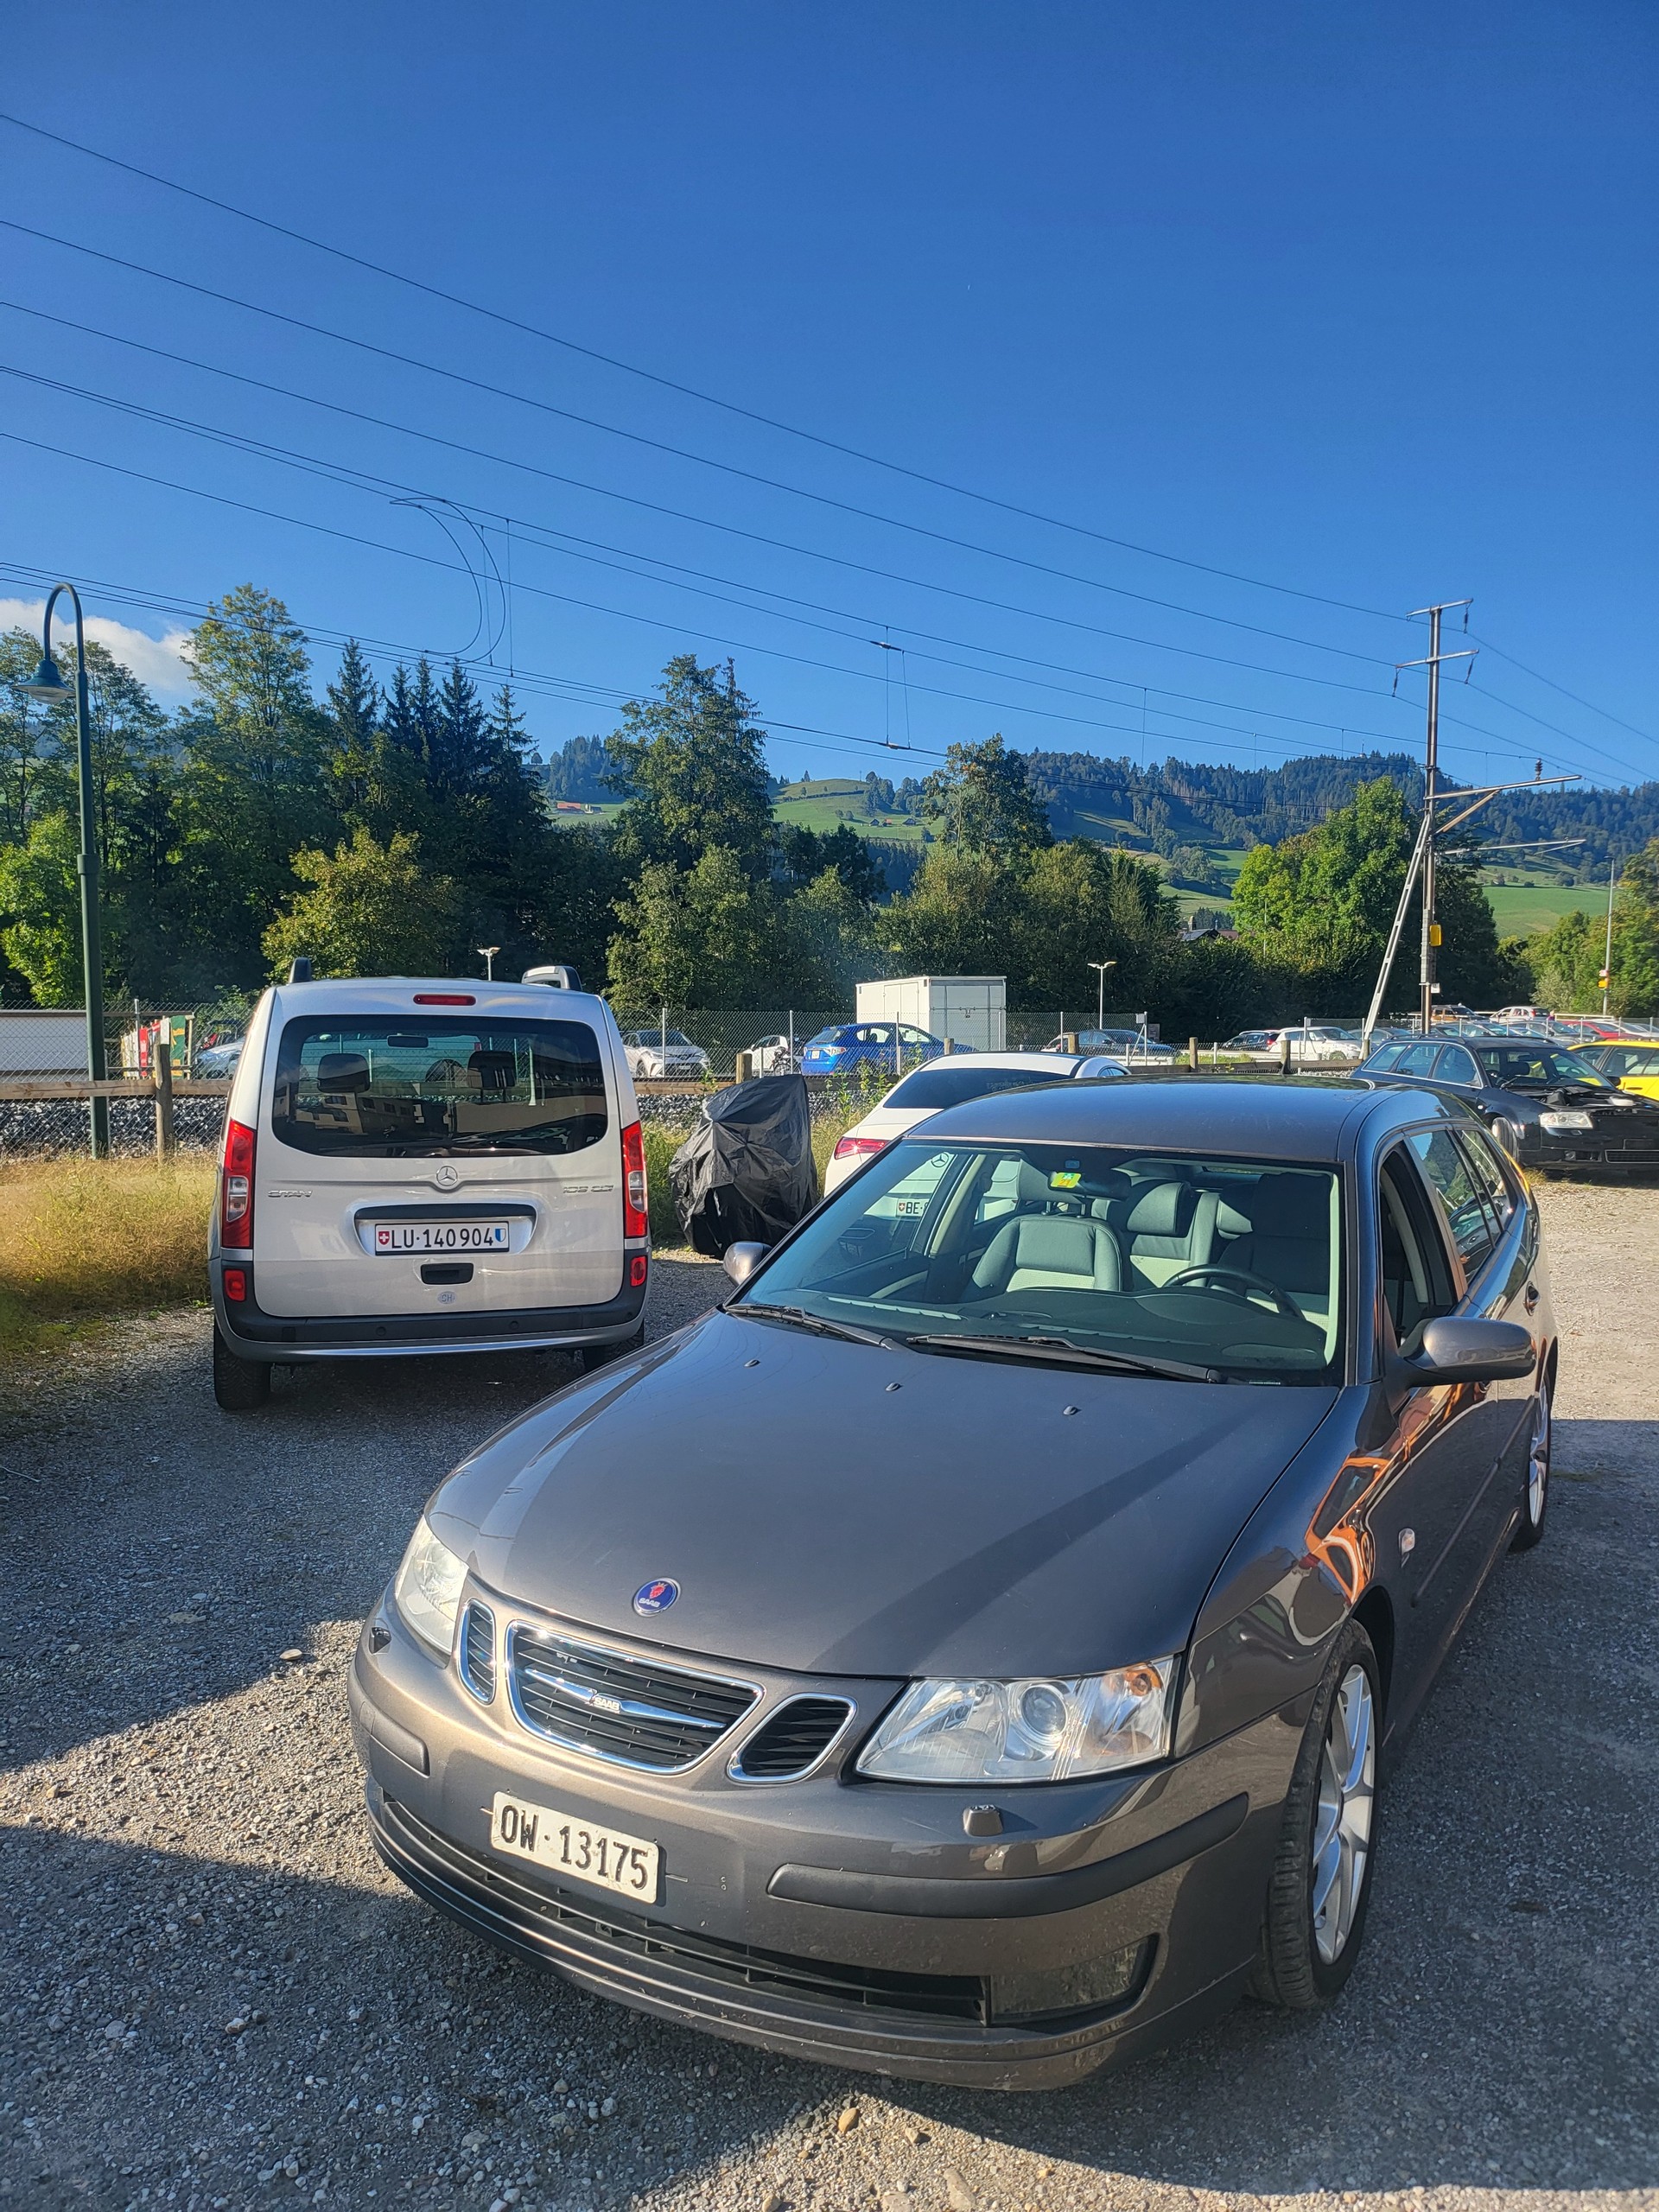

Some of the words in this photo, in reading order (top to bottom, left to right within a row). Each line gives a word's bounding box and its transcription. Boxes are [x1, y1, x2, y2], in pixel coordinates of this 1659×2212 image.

[442, 1294, 453, 1302] CH
[639, 1598, 661, 1608] SAAB
[594, 1696, 620, 1711] SAAB
